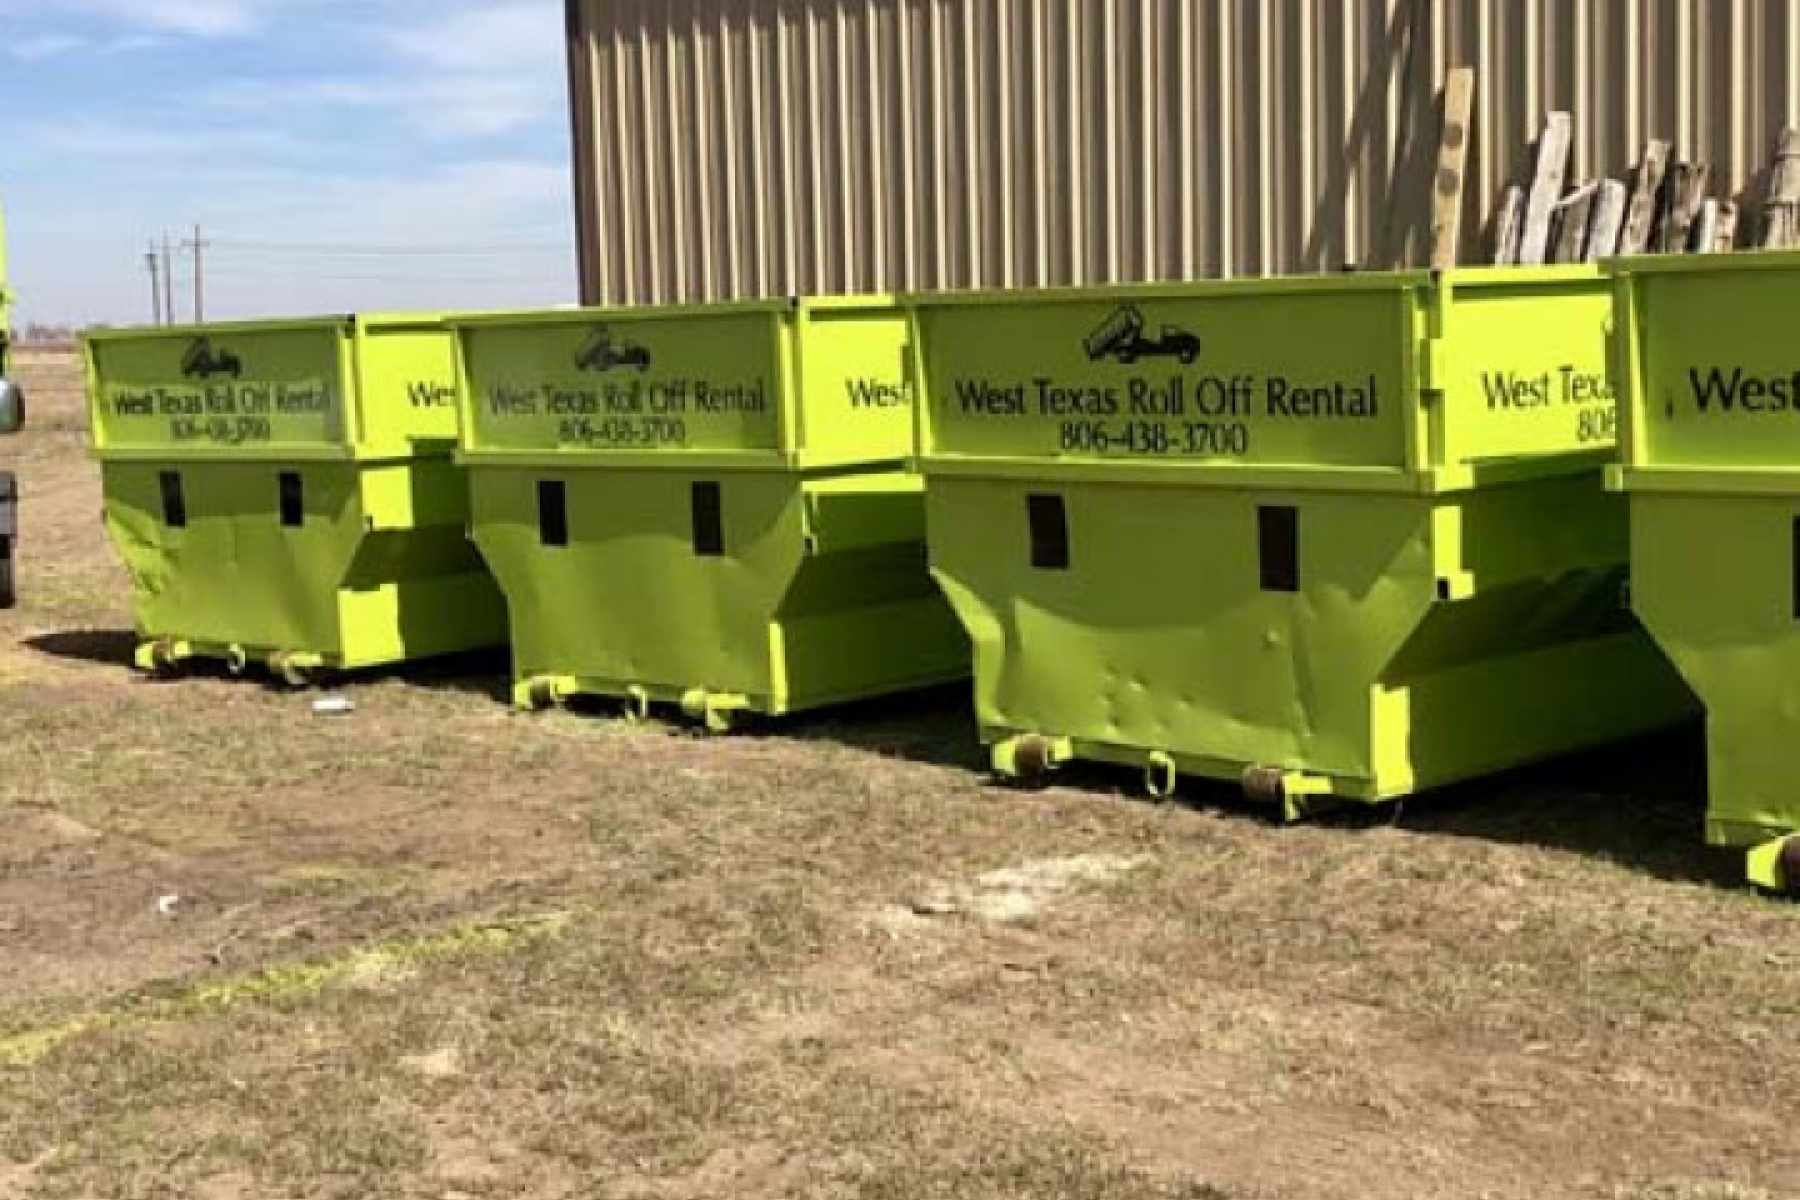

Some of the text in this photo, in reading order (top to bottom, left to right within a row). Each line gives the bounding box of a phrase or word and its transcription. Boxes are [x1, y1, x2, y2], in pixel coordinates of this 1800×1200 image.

[115, 382, 330, 415] West Texas Roll Off Rental
[489, 379, 766, 415] West Texas Roll Off Rental
[955, 374, 1378, 417] West Texas Roll Off Rental
[1481, 370, 1549, 409] West
[1060, 421, 1247, 455] 806-438-3700
